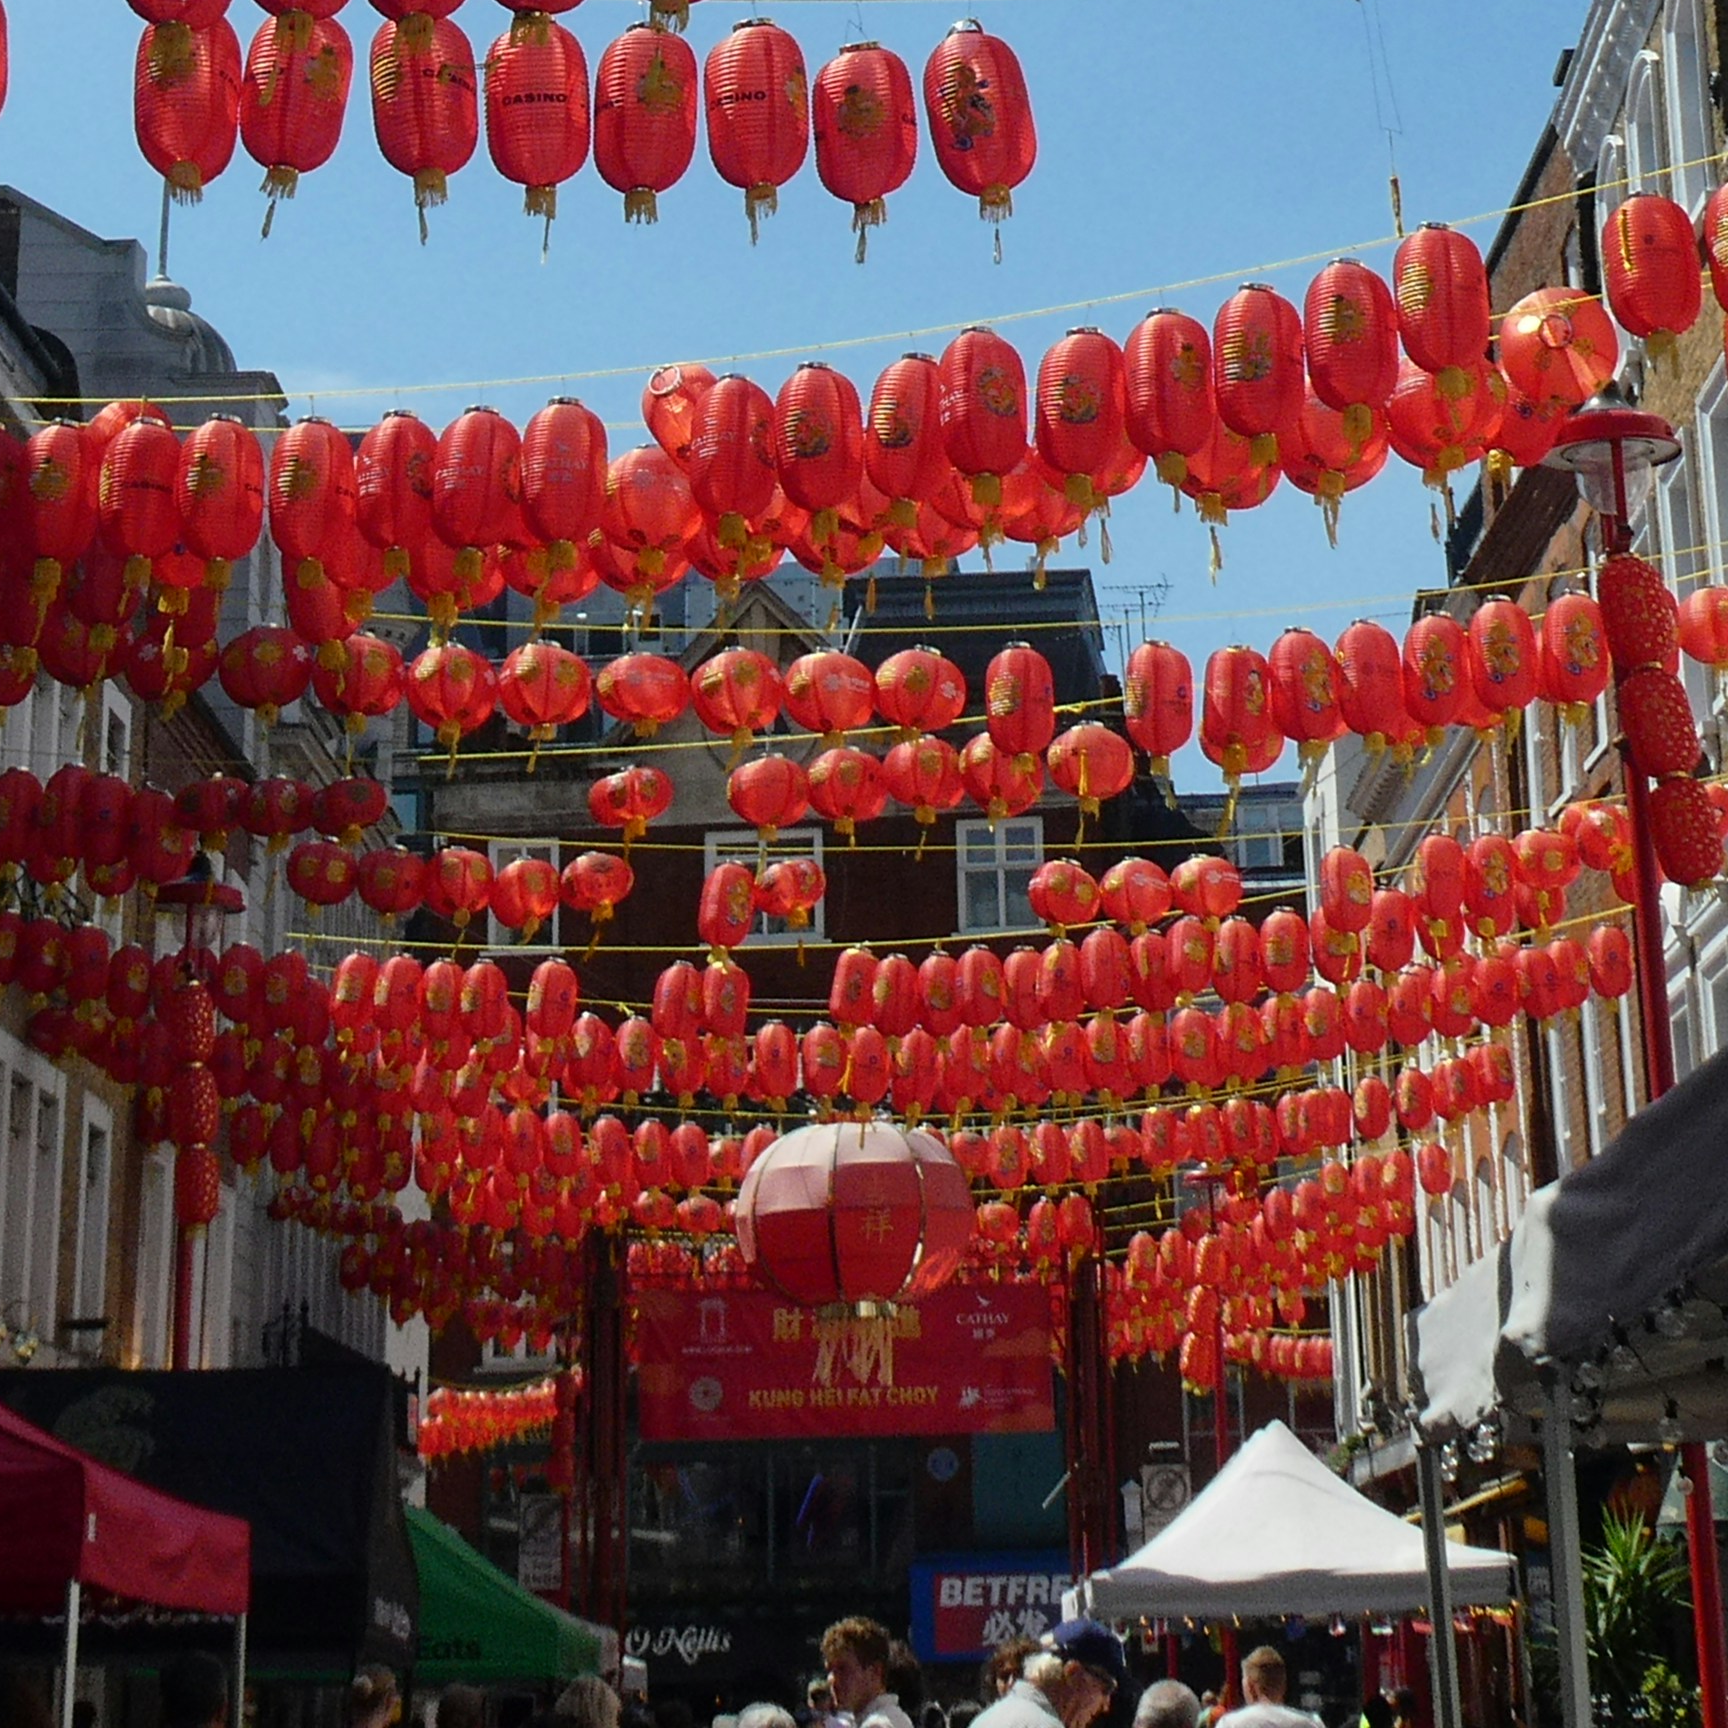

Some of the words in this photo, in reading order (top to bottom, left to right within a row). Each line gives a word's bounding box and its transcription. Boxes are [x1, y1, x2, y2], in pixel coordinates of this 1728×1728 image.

[502, 92, 568, 106] CASINO
[956, 1312, 1009, 1325] CATHAY
[748, 1389, 804, 1408] KUNG
[809, 1387, 843, 1407] HEI
[847, 1386, 882, 1407] FAT
[887, 1385, 939, 1406] CHOY
[939, 1574, 1073, 1608] BETFRE
